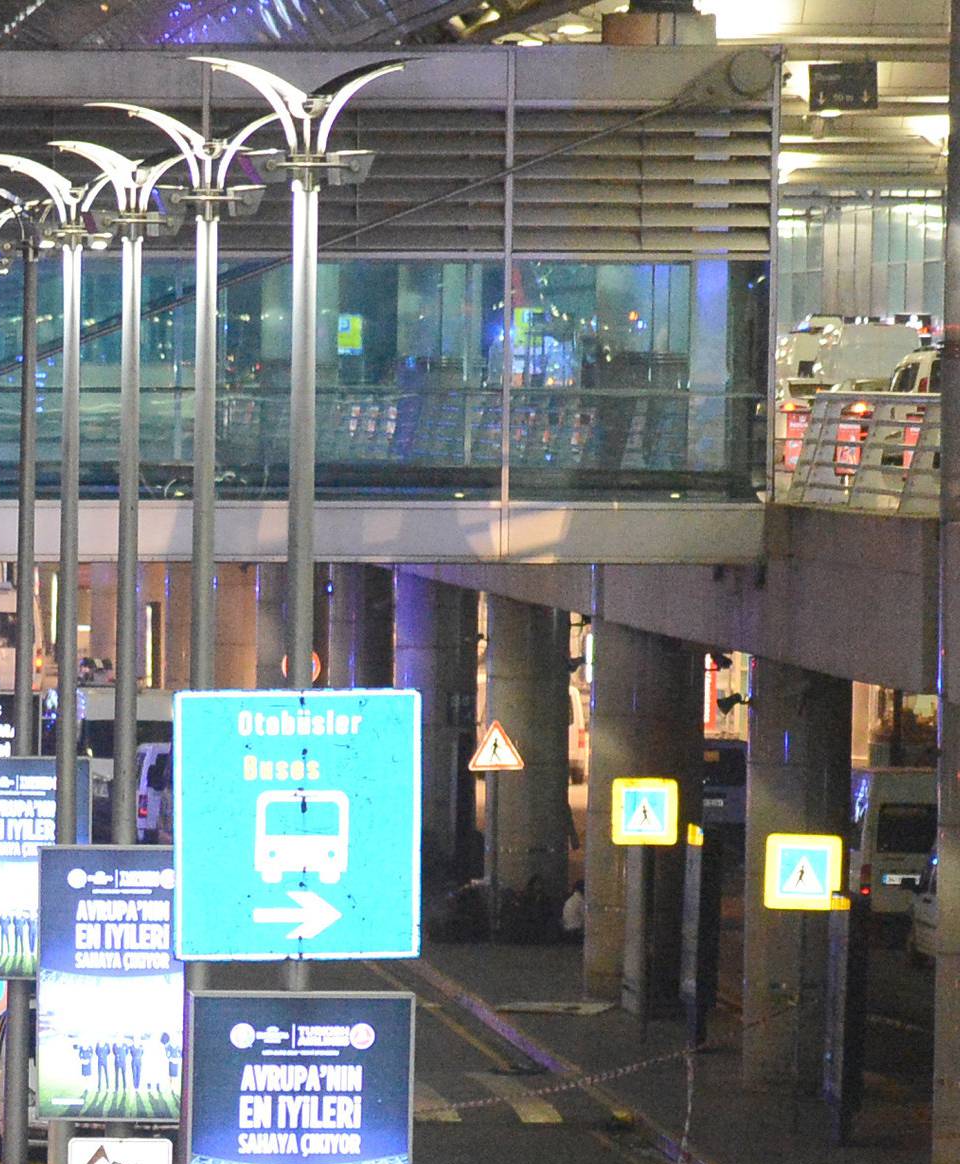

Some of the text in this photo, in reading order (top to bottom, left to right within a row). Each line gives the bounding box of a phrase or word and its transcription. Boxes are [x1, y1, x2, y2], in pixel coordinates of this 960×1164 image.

[243, 755, 320, 781] Buses
[75, 923, 101, 950] EN
[240, 1064, 363, 1092] AVRUPA'NIN
[239, 1095, 362, 1129] EN İYİLERİ
[238, 1133, 362, 1157] SAHAYA ÇIKIYOR
